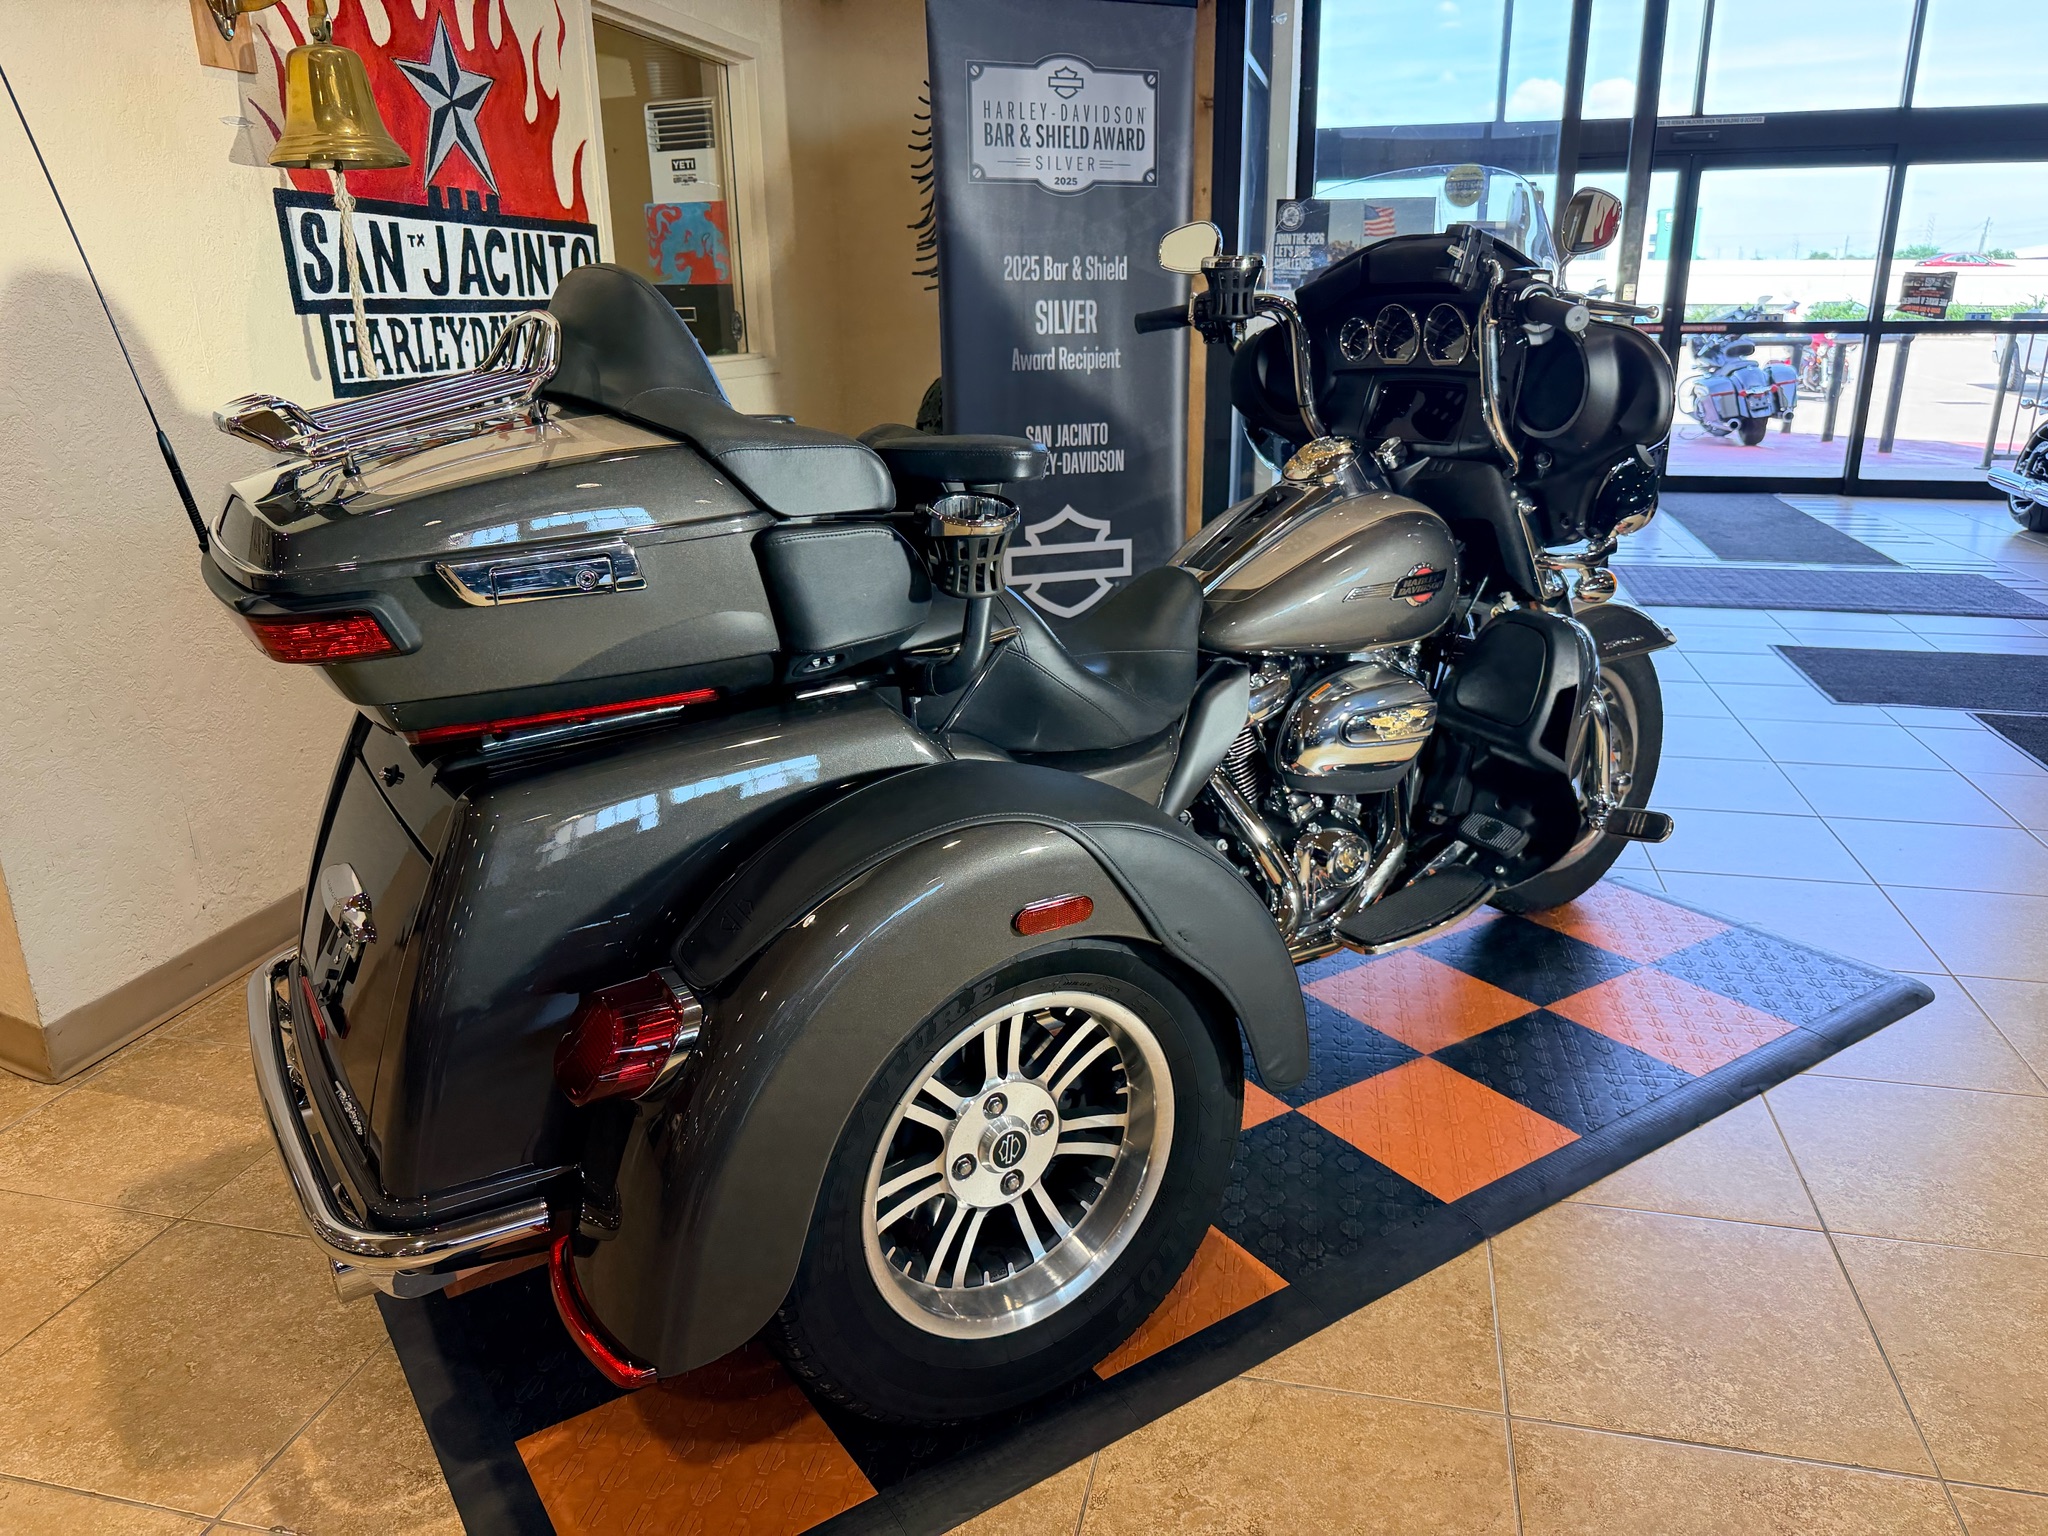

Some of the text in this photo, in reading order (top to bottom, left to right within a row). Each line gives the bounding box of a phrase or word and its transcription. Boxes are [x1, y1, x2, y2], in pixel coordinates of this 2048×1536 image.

[984, 122, 1146, 151] BAR & SHIELD AWARD
[672, 160, 695, 170] YETI
[1035, 155, 1096, 171] SILVER
[1054, 177, 1078, 186] 2025
[1275, 233, 1291, 245] JOIN
[1292, 232, 1305, 245] THE
[300, 211, 407, 295] SAN
[407, 234, 425, 248] TX
[1004, 256, 1128, 281] 2025 Bar & Shield
[1035, 300, 1098, 335] SILVER
[1012, 346, 1121, 374] Award Recipient
[1025, 422, 1109, 447] SAN JACINTO
[1044, 450, 1125, 475] Y-DAVIDSON
